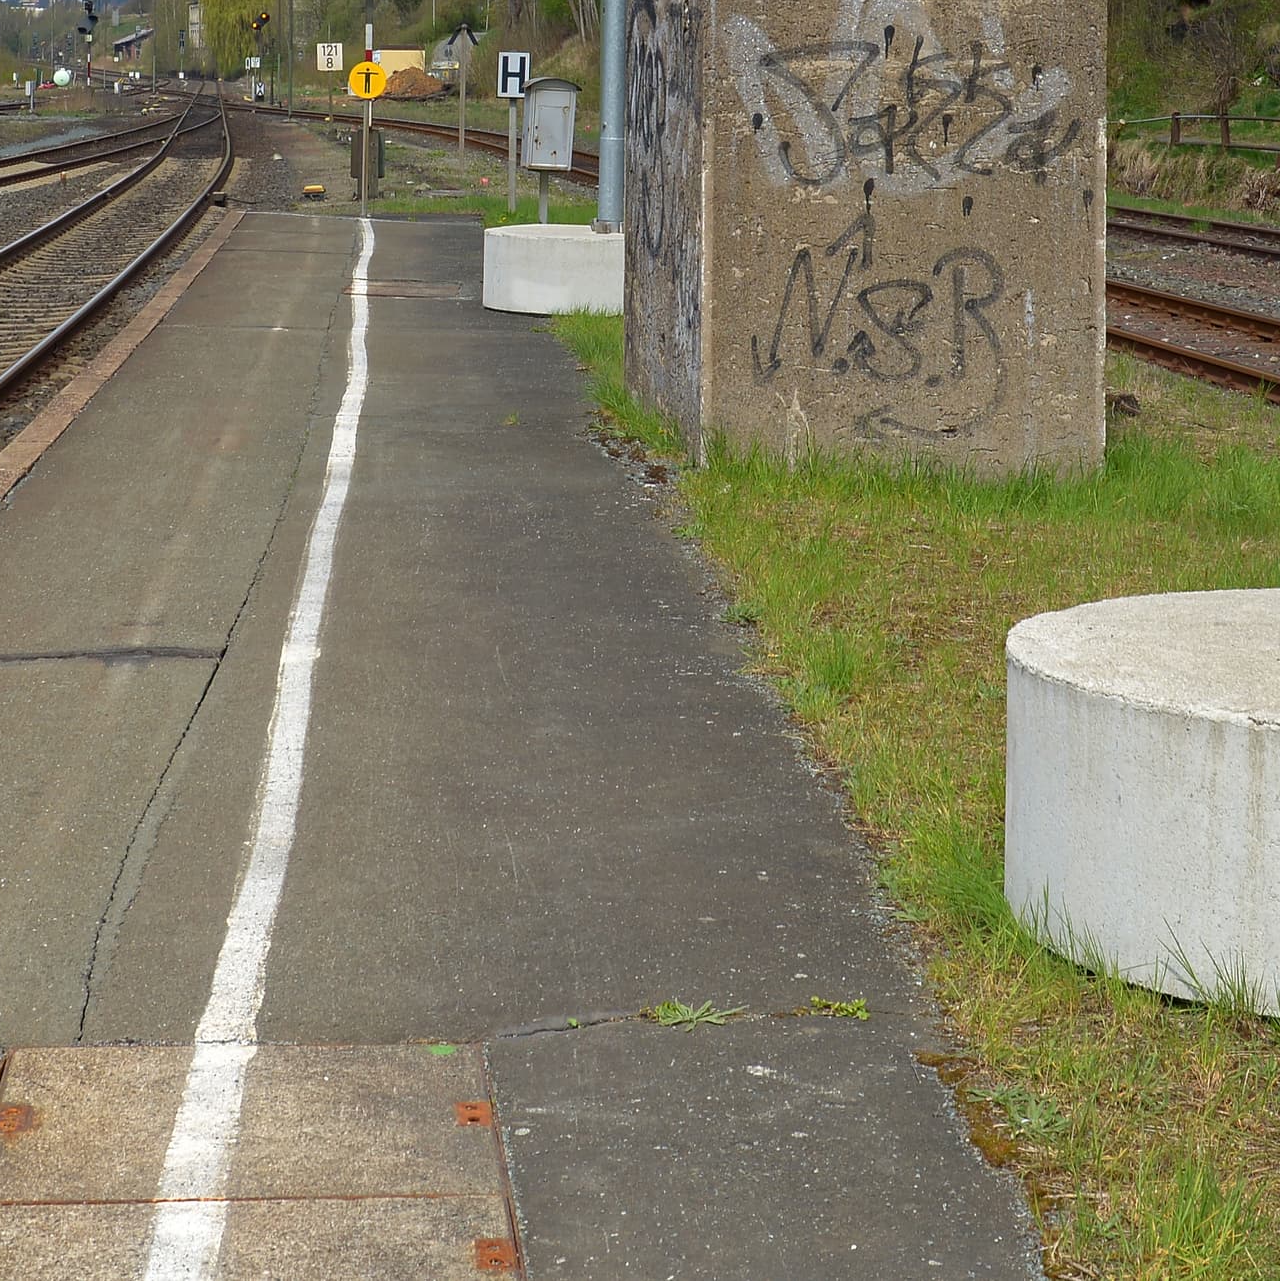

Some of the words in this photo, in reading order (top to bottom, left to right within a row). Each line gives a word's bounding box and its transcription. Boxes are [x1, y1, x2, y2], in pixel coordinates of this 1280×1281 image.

[321, 45, 338, 56] 121
[326, 58, 333, 68] 8
[501, 55, 526, 94] H
